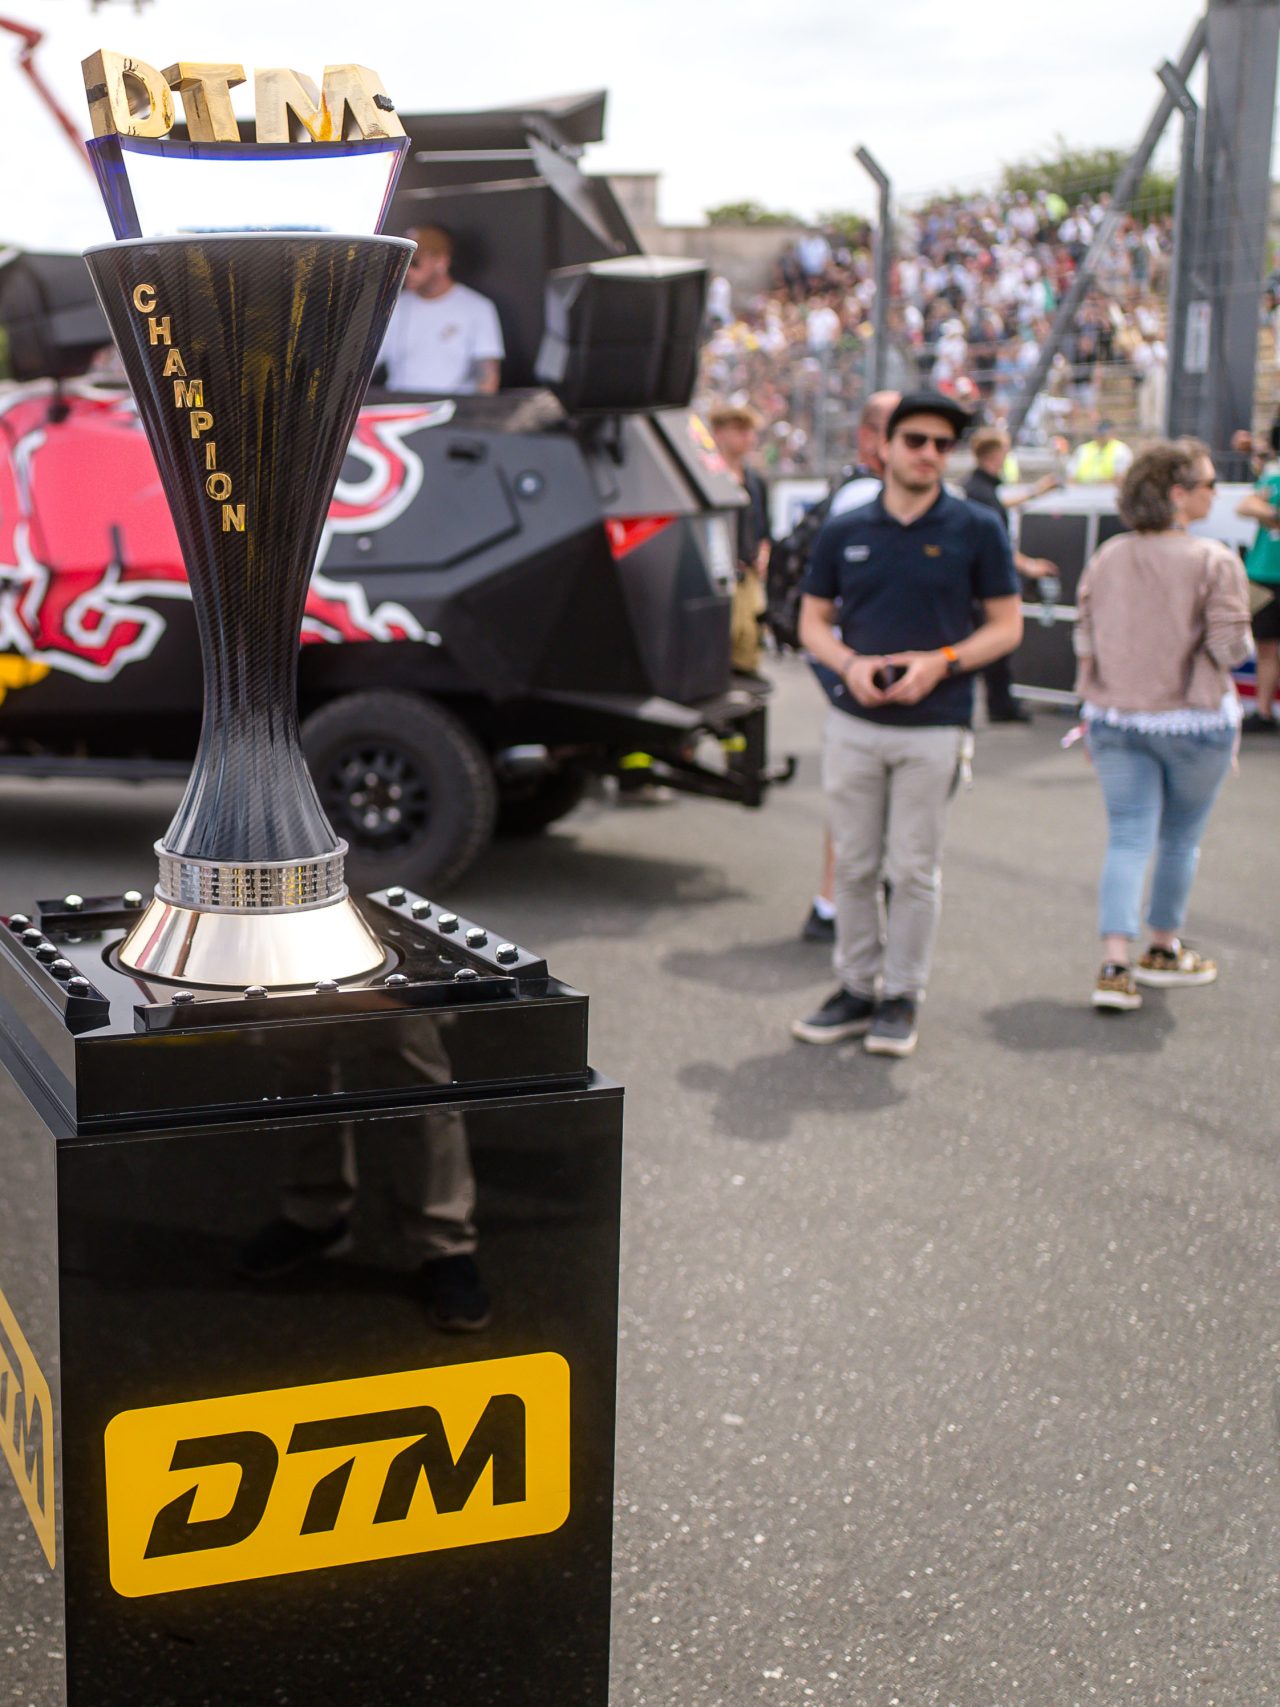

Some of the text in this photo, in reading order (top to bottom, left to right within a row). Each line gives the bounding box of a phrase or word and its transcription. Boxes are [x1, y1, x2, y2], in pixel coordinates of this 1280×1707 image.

[81, 48, 406, 143] DTM
[133, 283, 245, 532] CHAMPION
[143, 1393, 526, 1560] DTM
